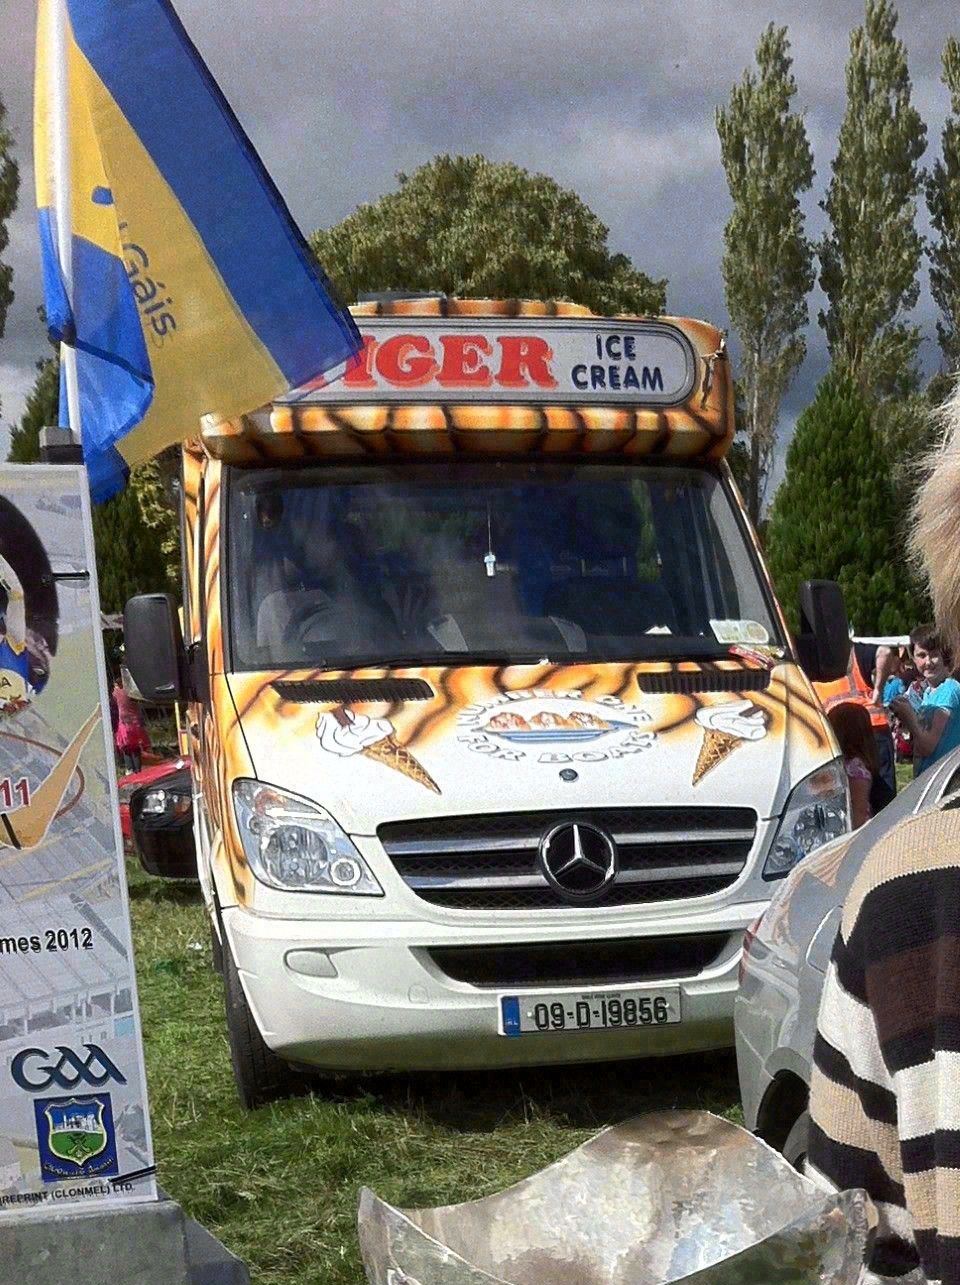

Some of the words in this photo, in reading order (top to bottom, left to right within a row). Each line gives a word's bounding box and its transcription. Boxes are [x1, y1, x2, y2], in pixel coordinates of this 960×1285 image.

[593, 334, 637, 361] ICE
[302, 334, 560, 390] IGER
[570, 364, 665, 392] CREAM
[45, 928, 93, 952] 2012
[0, 1190, 49, 1206] REPRINT
[51, 1184, 111, 1202] (CLONMEL)
